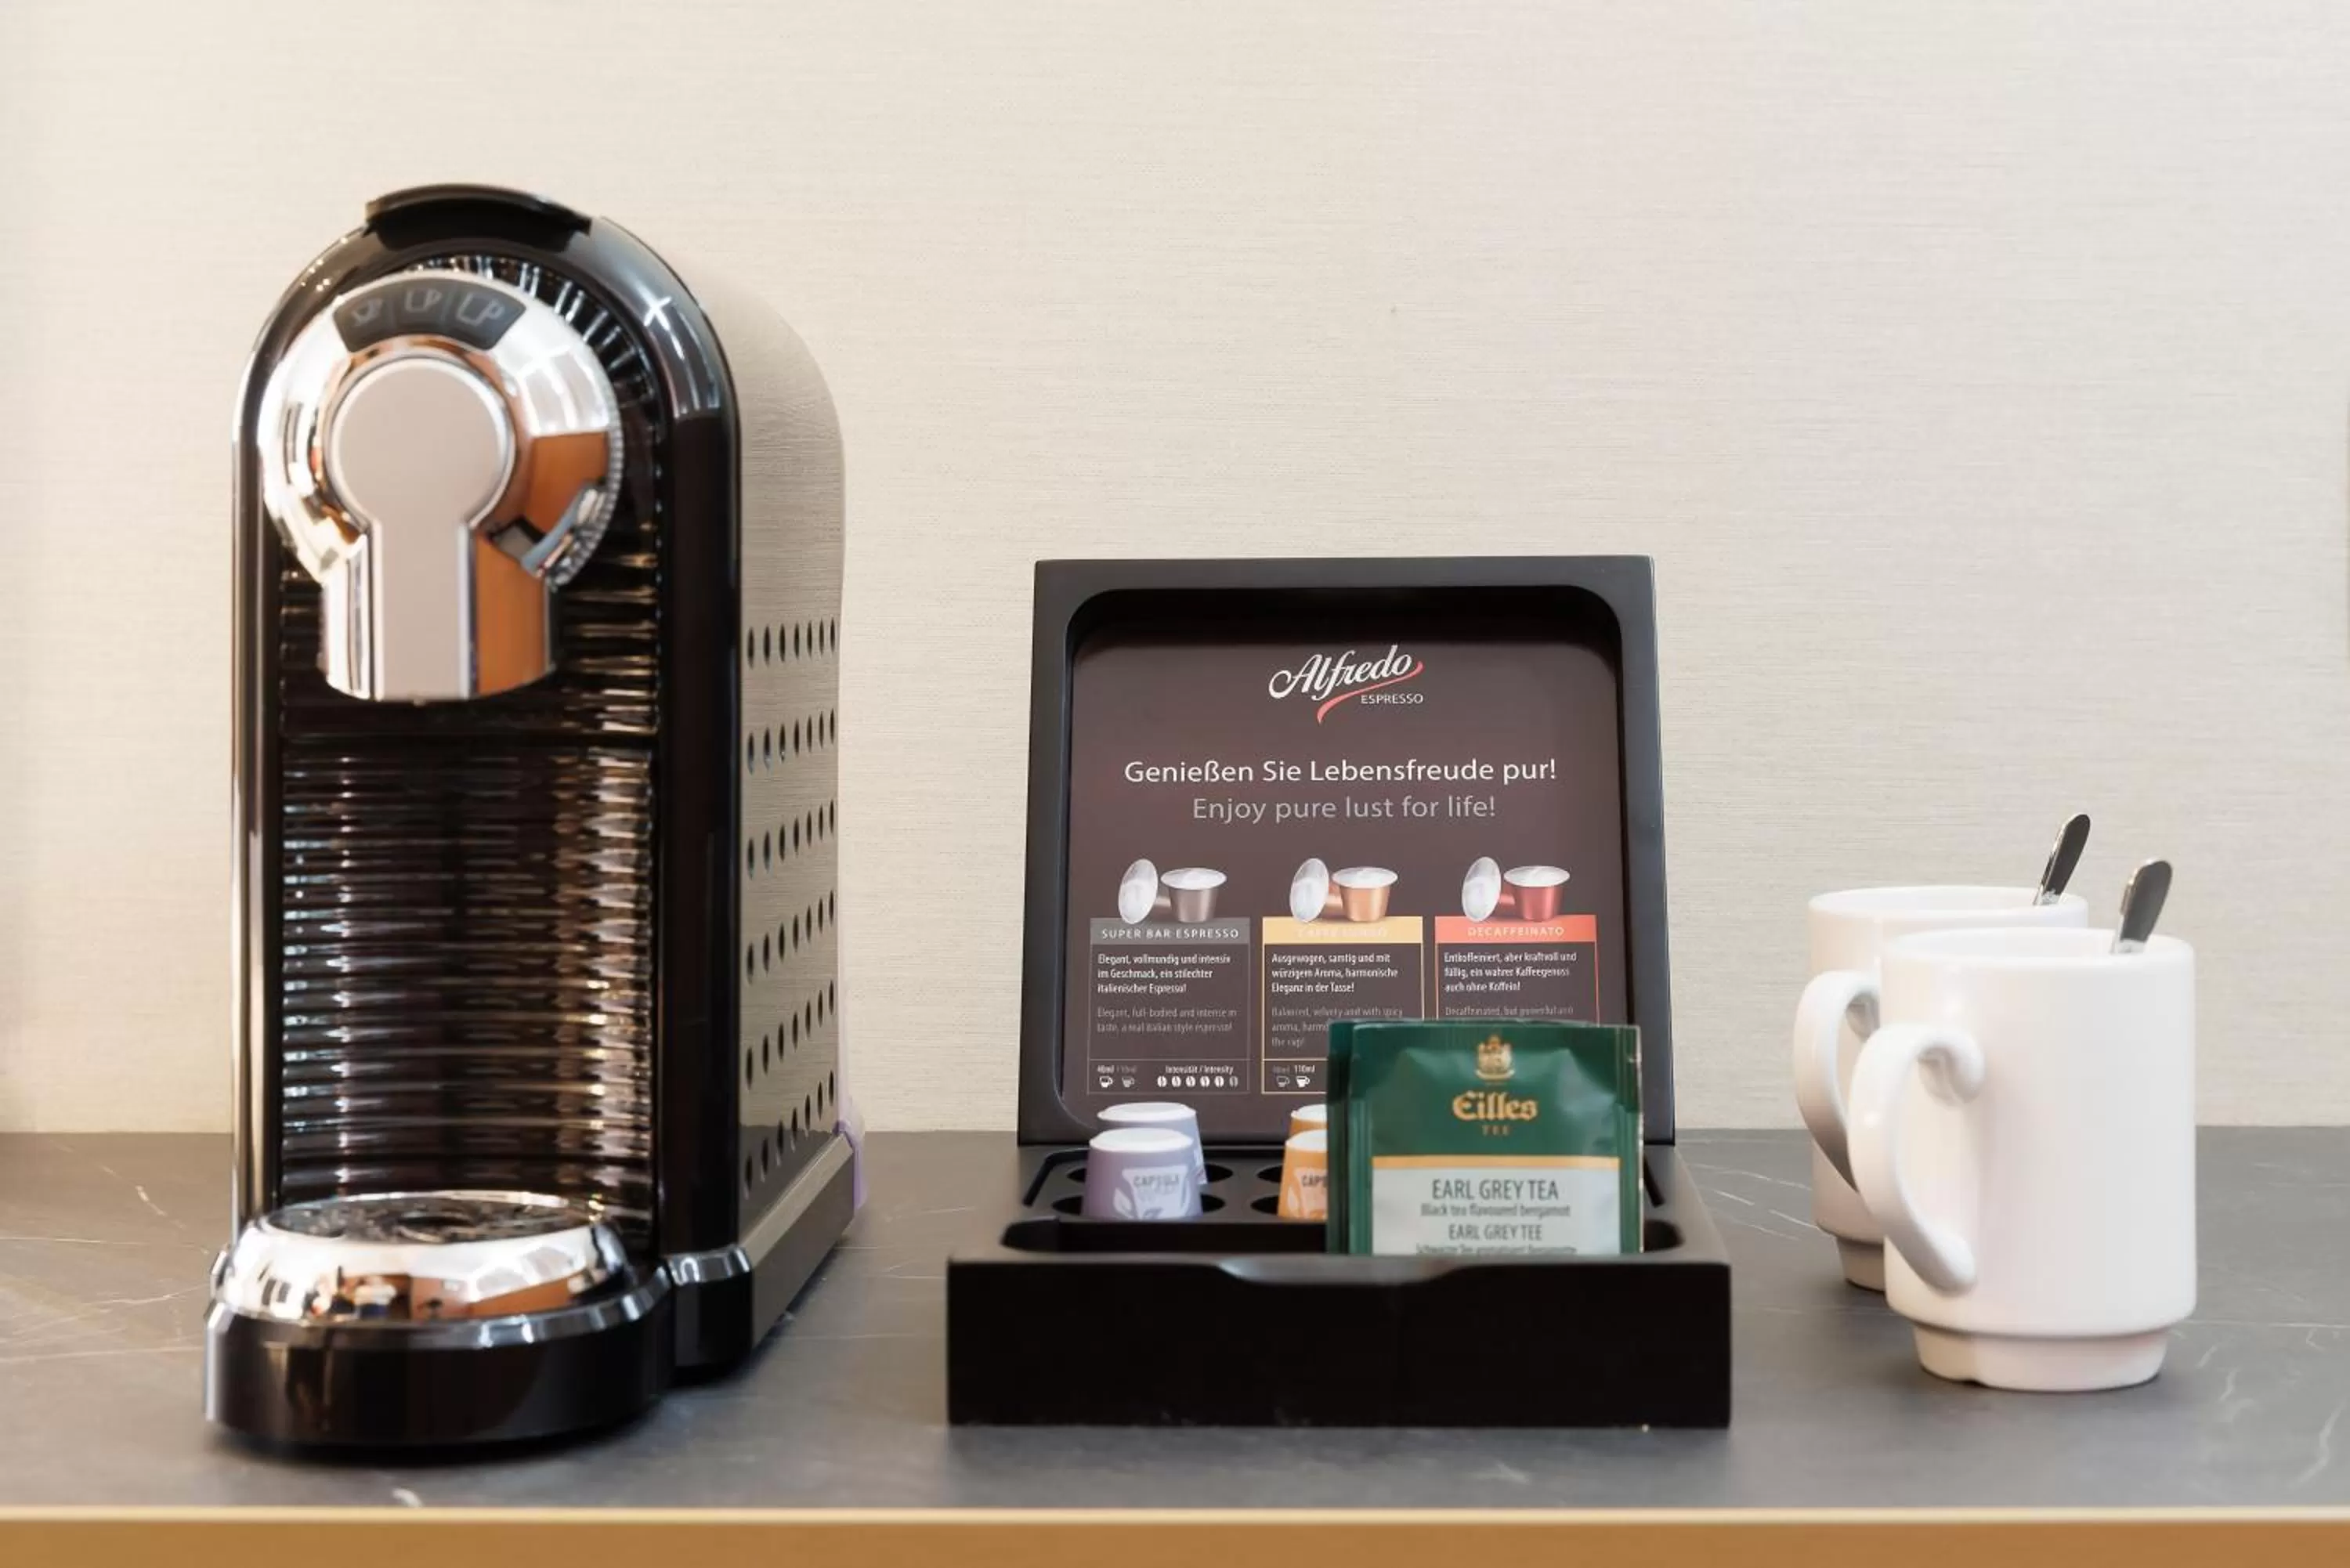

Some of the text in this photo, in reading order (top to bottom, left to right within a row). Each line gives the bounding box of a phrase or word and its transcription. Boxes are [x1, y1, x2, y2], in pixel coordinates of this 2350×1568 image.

[1269, 645, 1412, 701] Alfredo
[1361, 693, 1423, 704] ESPRESSO
[1124, 759, 1556, 786] Genießen Sie Lebensfreude pur!
[1192, 795, 1495, 824] Enjoy pure lust for life!
[1101, 928, 1239, 939] SUPER BAR ESPRESSO
[1467, 926, 1564, 937] DECAFFEINATO
[1097, 953, 1131, 966] Elegant,
[1133, 953, 1179, 965] vollmundig
[1180, 954, 1198, 964] und
[1271, 953, 1326, 966] Ausgewogen,
[1358, 952, 1375, 963] und
[1376, 952, 1391, 963] mit
[1444, 951, 1578, 963] Entkoffeiniert, aber kraftvoll und
[1097, 968, 1213, 980] im Geschmack, ein stilechter
[1314, 969, 1343, 979] Aroma,
[1345, 967, 1398, 978] harmonische
[1470, 966, 1483, 977] ein
[1484, 966, 1513, 977] wahrer
[1271, 982, 1354, 995] Eleganz in der Tasse!
[1444, 981, 1520, 992] auch ohne Koffein!
[1302, 1022, 1329, 1032] harmo
[1452, 1089, 1539, 1121] Eilles
[1431, 1179, 1560, 1201] EARL GREY TEA
[1448, 1223, 1542, 1241] EARL GREY TEE
